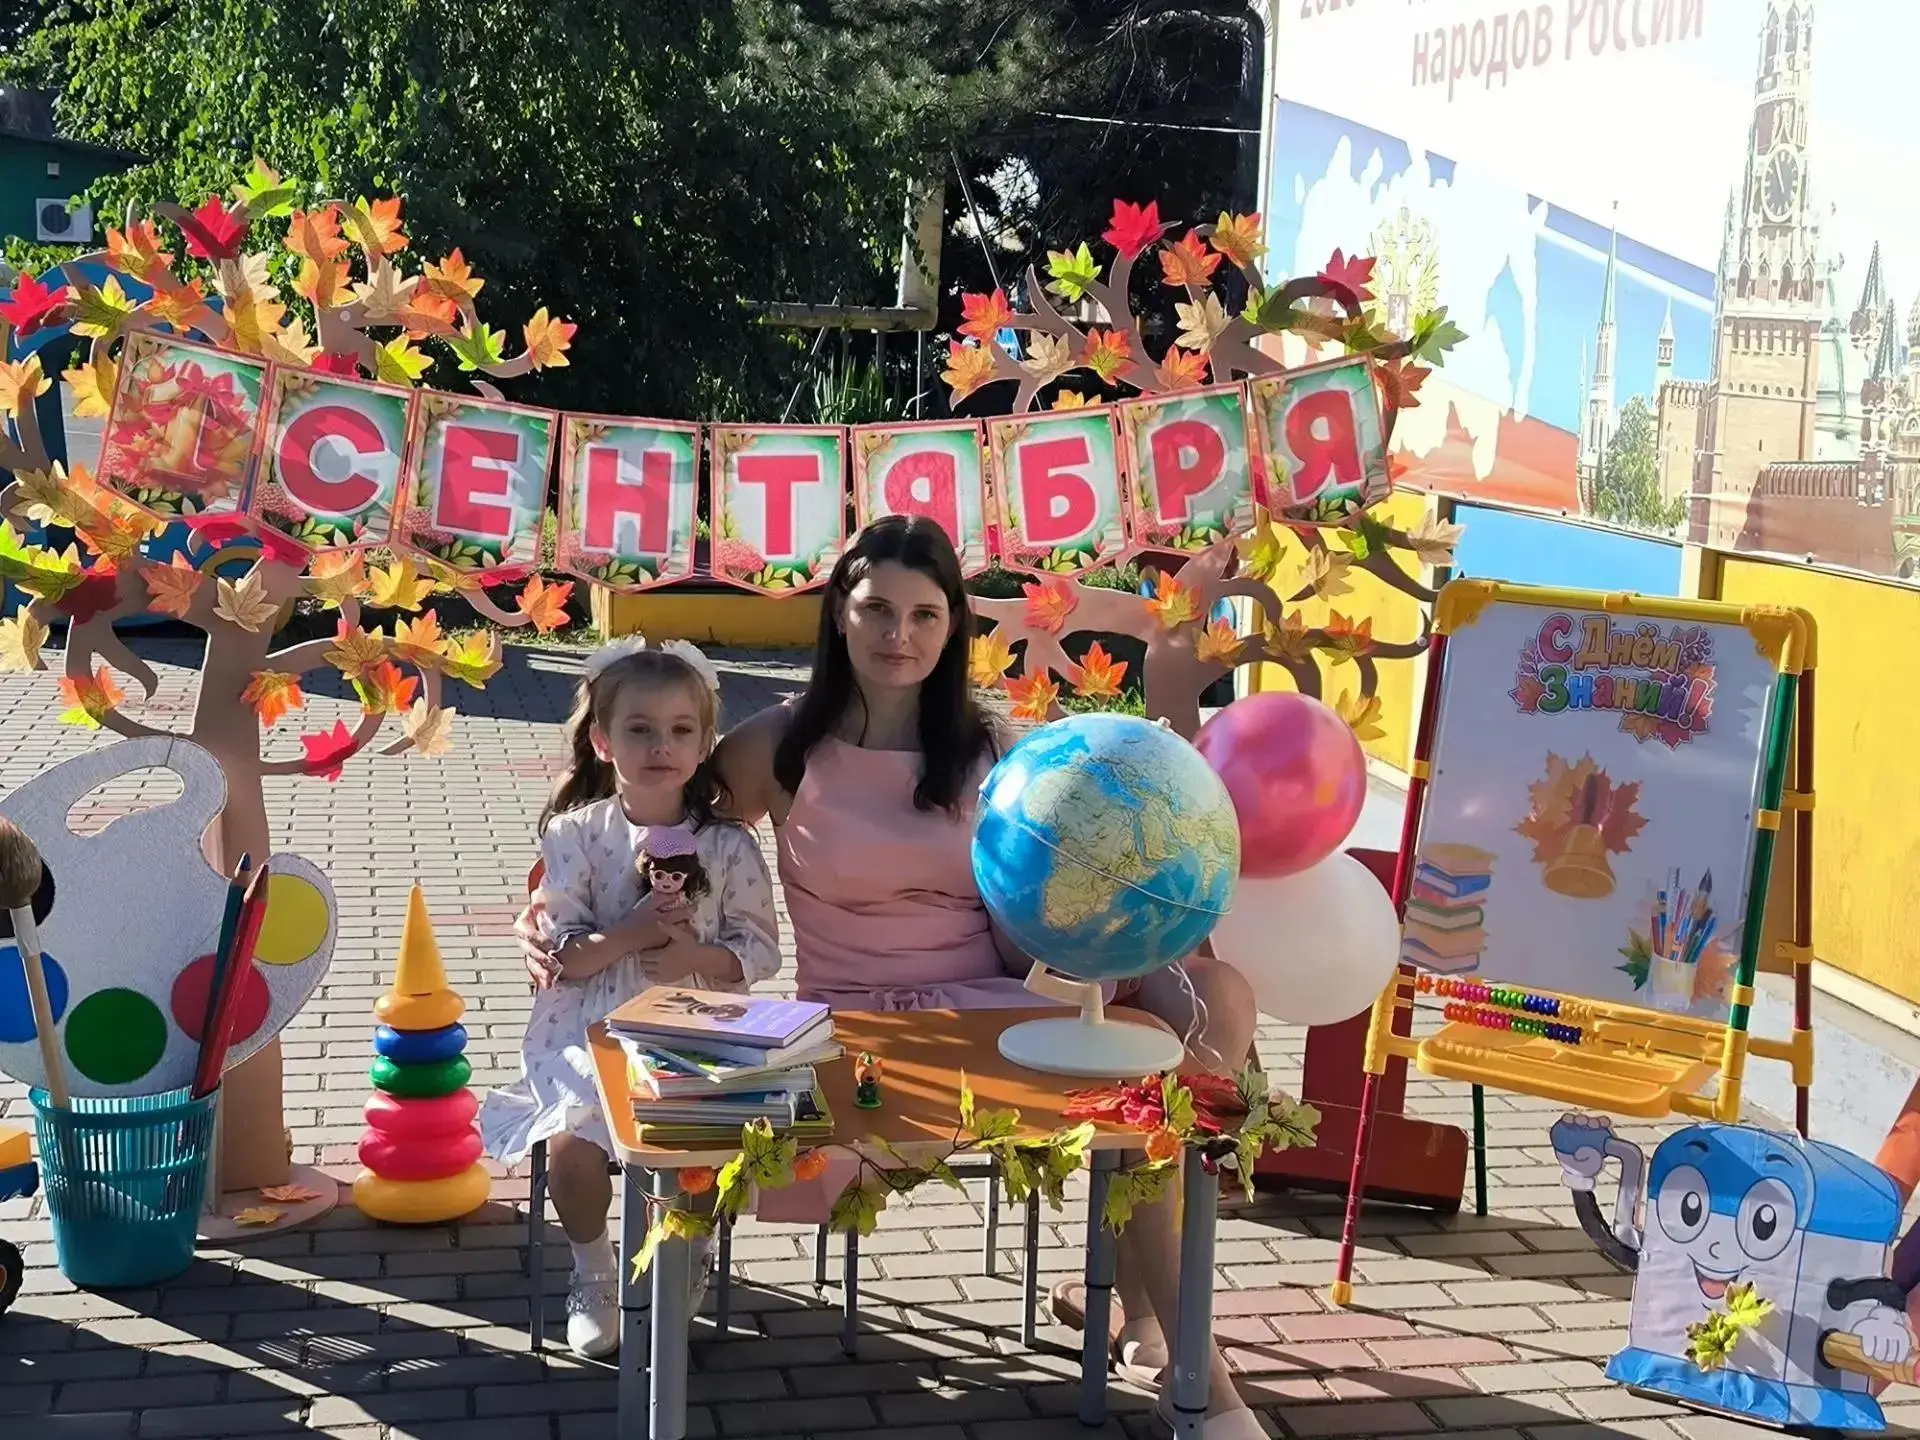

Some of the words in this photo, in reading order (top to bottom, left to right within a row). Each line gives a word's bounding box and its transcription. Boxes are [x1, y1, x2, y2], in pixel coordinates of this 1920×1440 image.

[1412, 4, 1553, 103] народов
[1564, 0, 1704, 60] России
[277, 388, 1365, 558] СЕНТЯБРЯ
[1538, 614, 1574, 664] С
[1574, 615, 1683, 674] Днём
[1537, 665, 1709, 729] Знаний!
